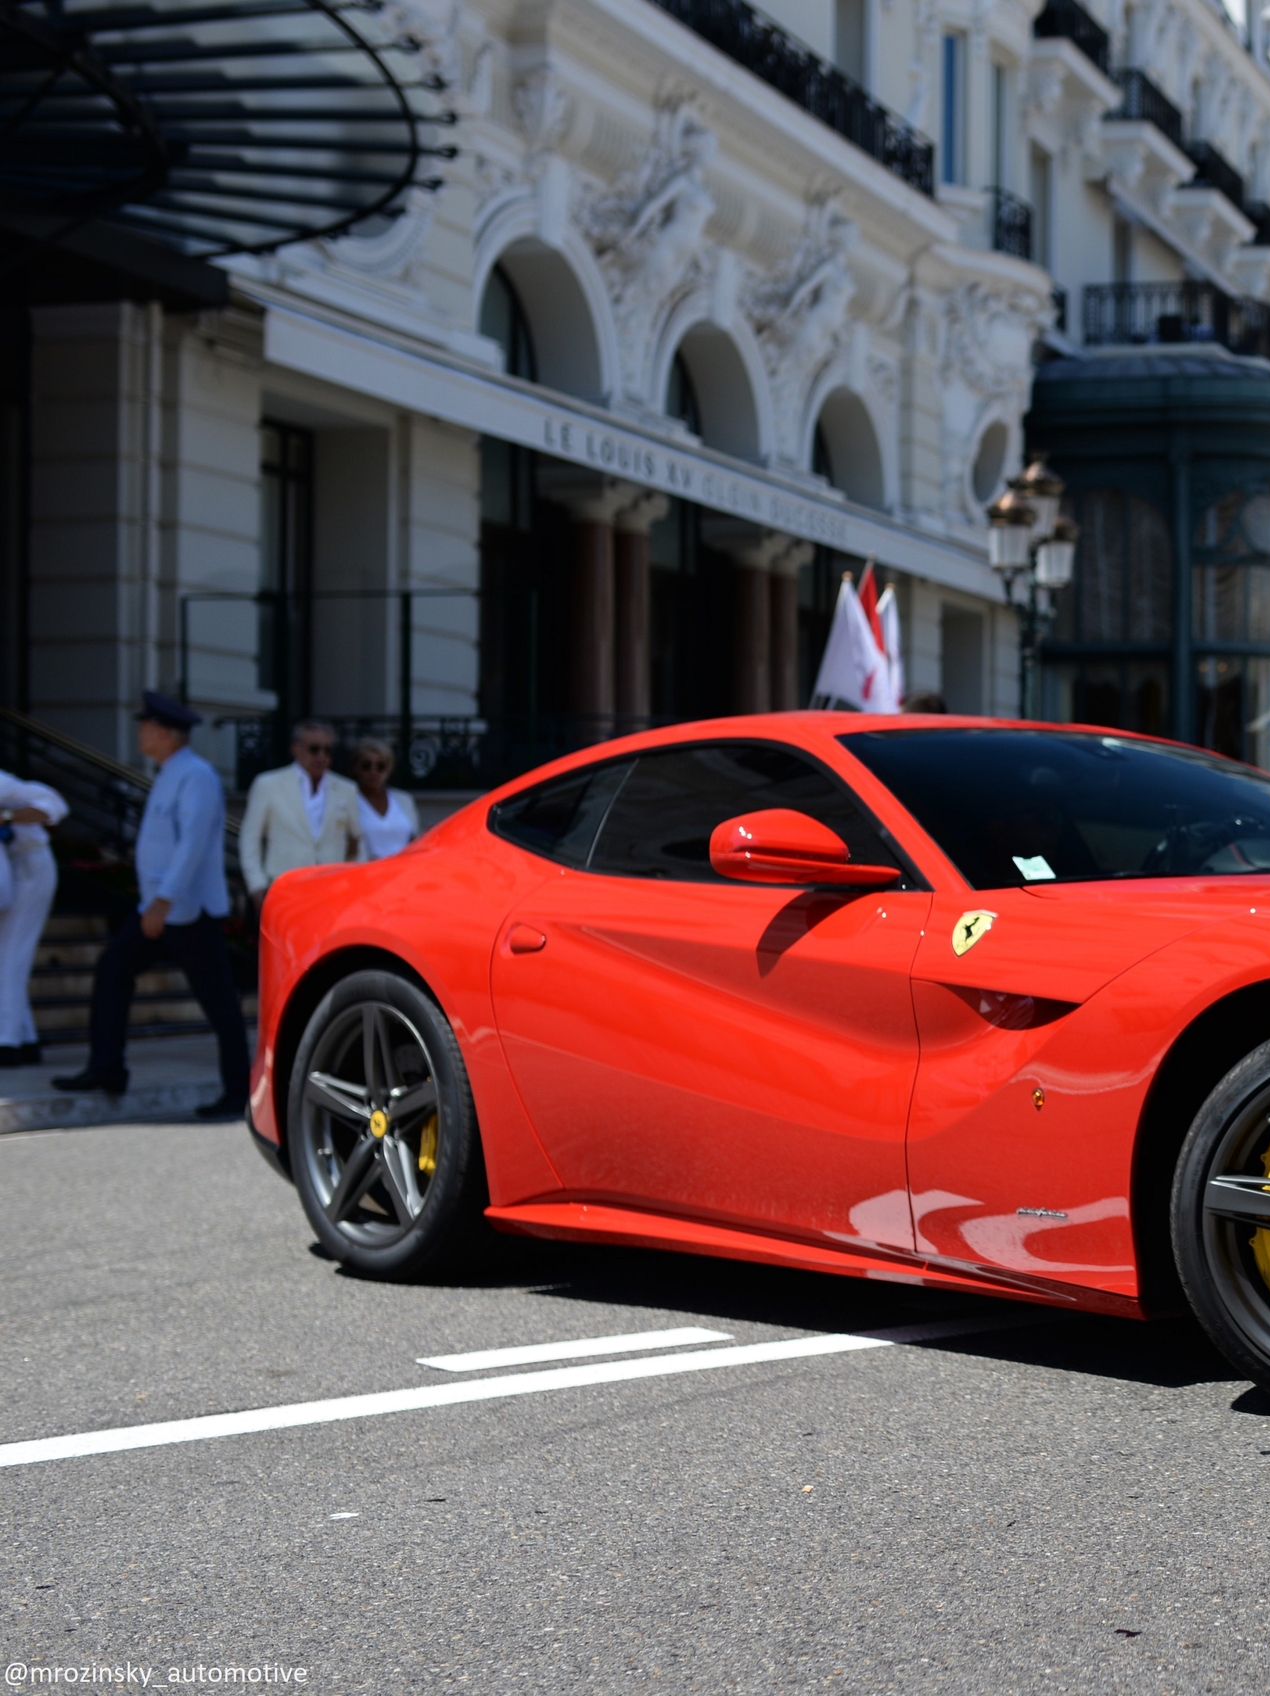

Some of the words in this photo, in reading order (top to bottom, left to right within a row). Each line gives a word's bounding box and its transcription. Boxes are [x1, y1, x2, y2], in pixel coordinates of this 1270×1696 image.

[544, 416, 571, 452] LE
[586, 431, 656, 477] LOUIS
[666, 458, 692, 489] XV
